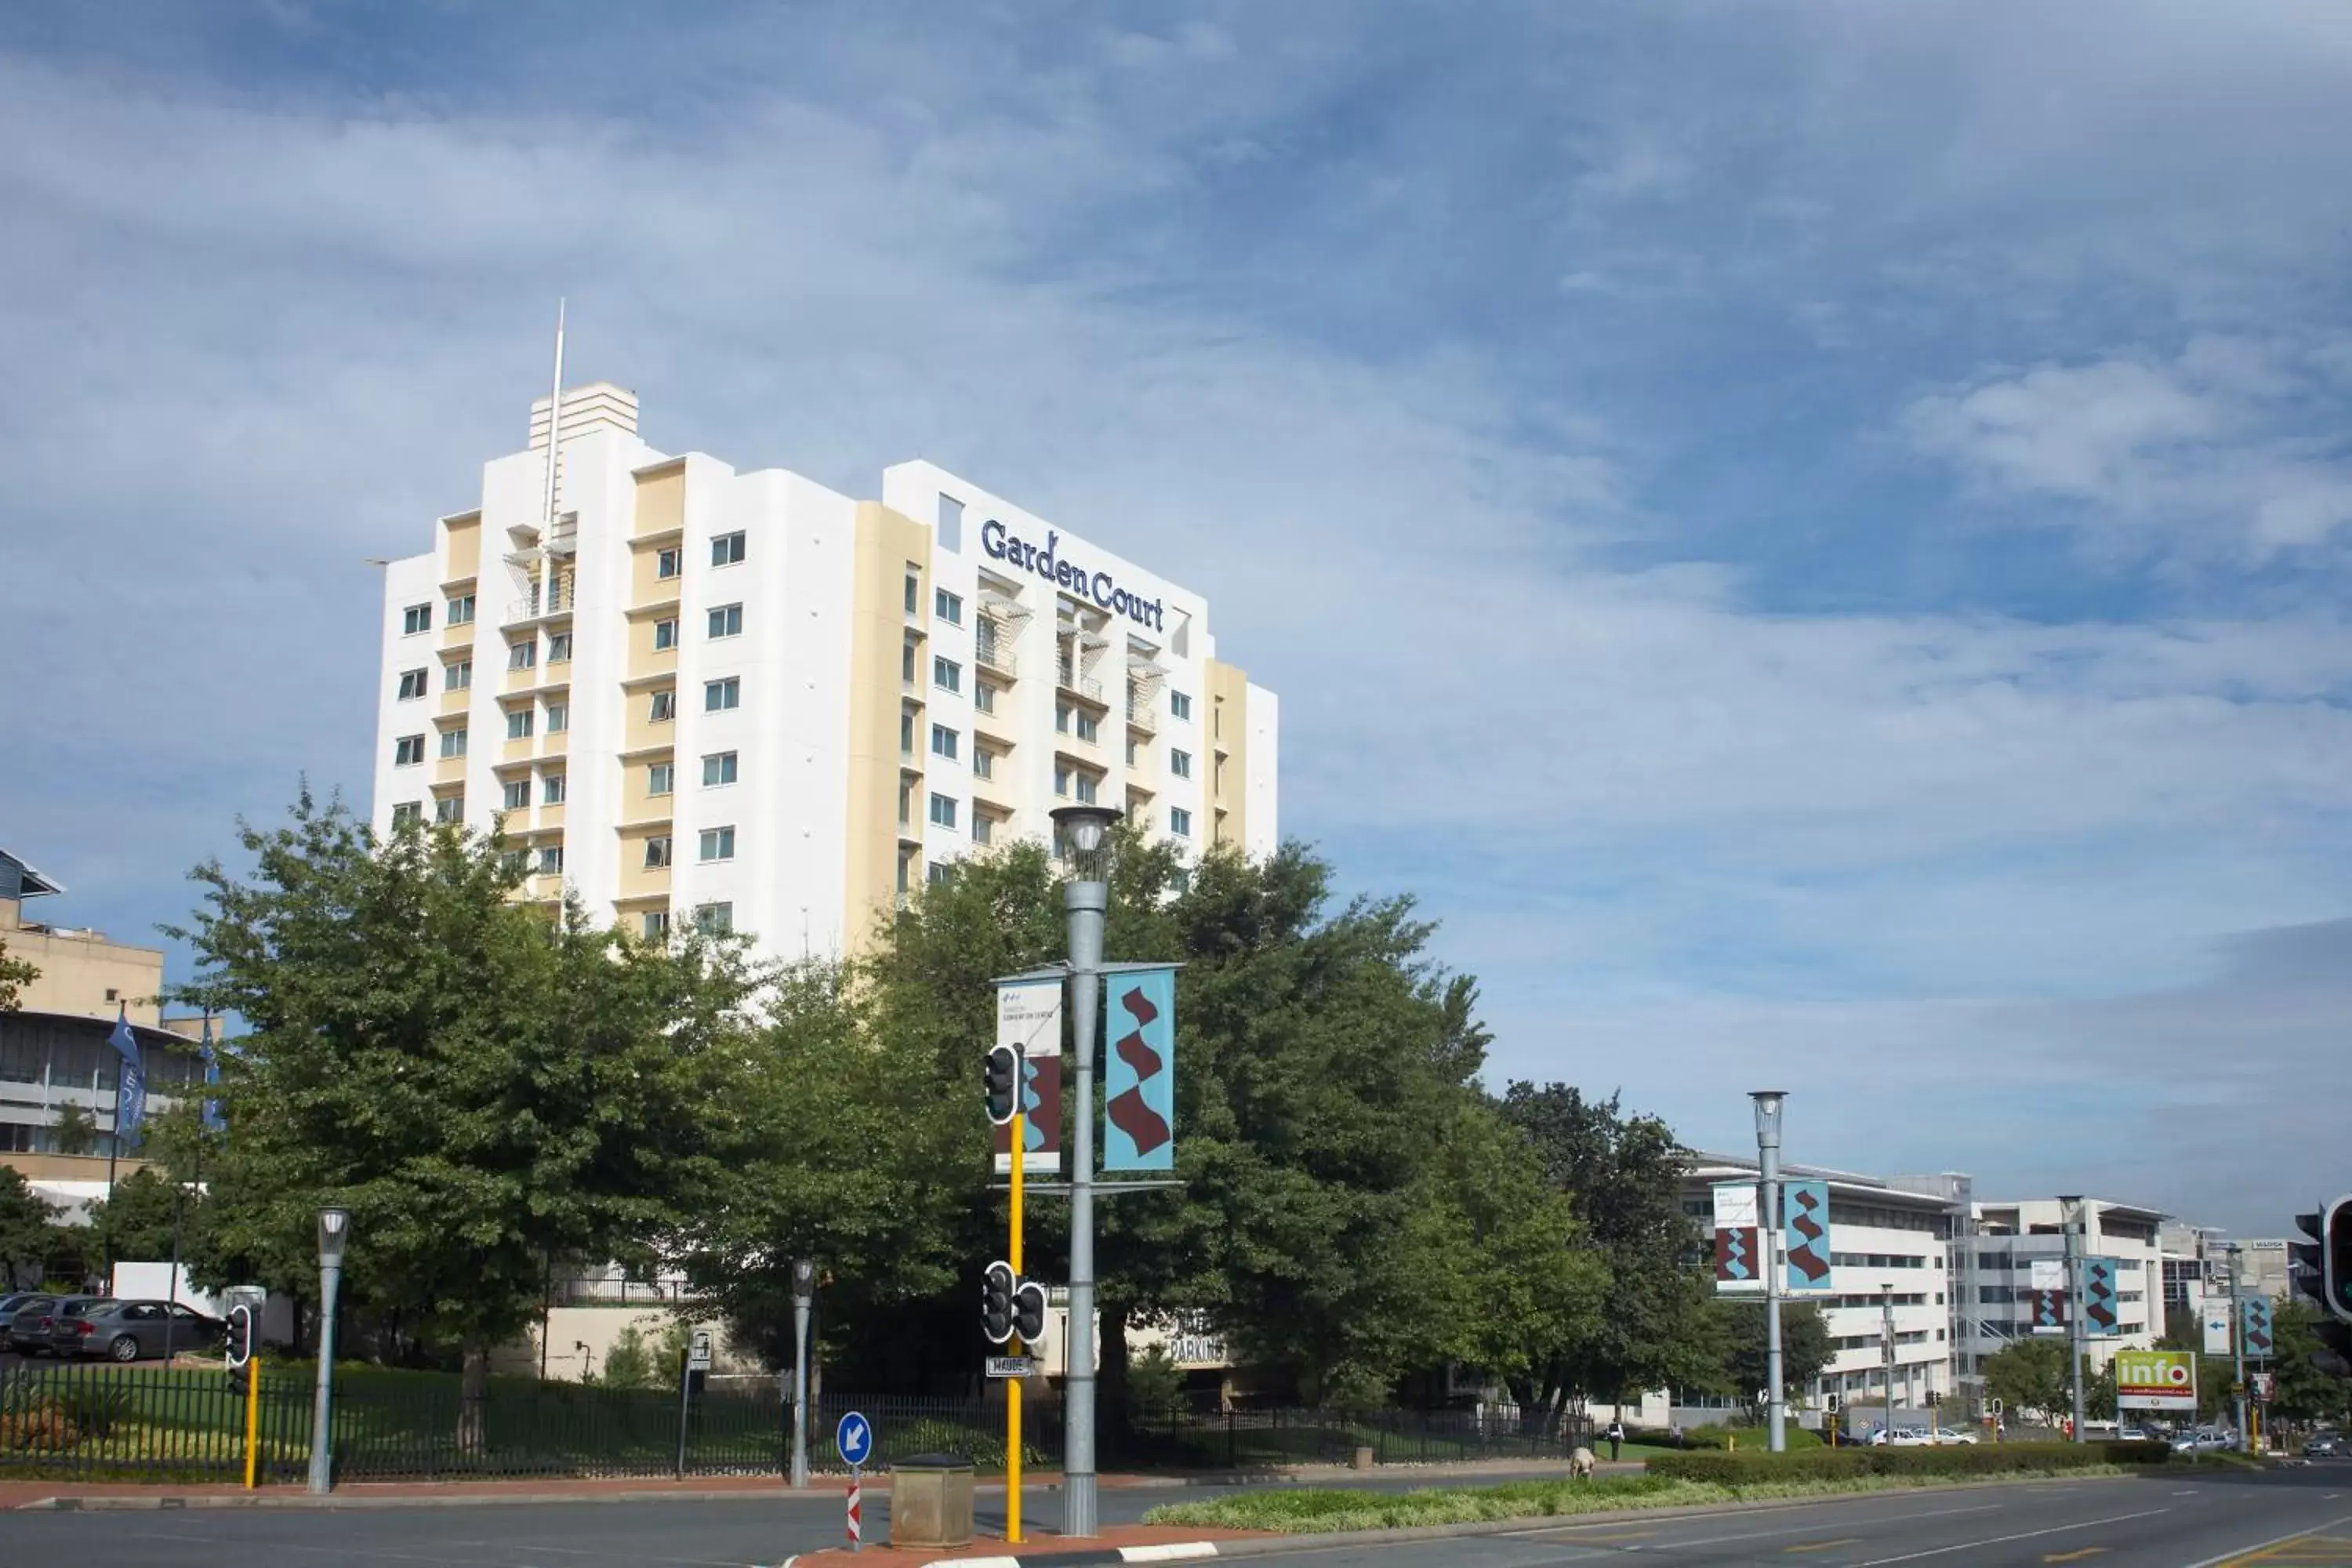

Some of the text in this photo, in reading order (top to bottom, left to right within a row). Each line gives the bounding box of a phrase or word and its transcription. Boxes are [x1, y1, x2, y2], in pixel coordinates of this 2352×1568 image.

[982, 520, 1163, 633] Garden Court
[2121, 1359, 2188, 1385] info
